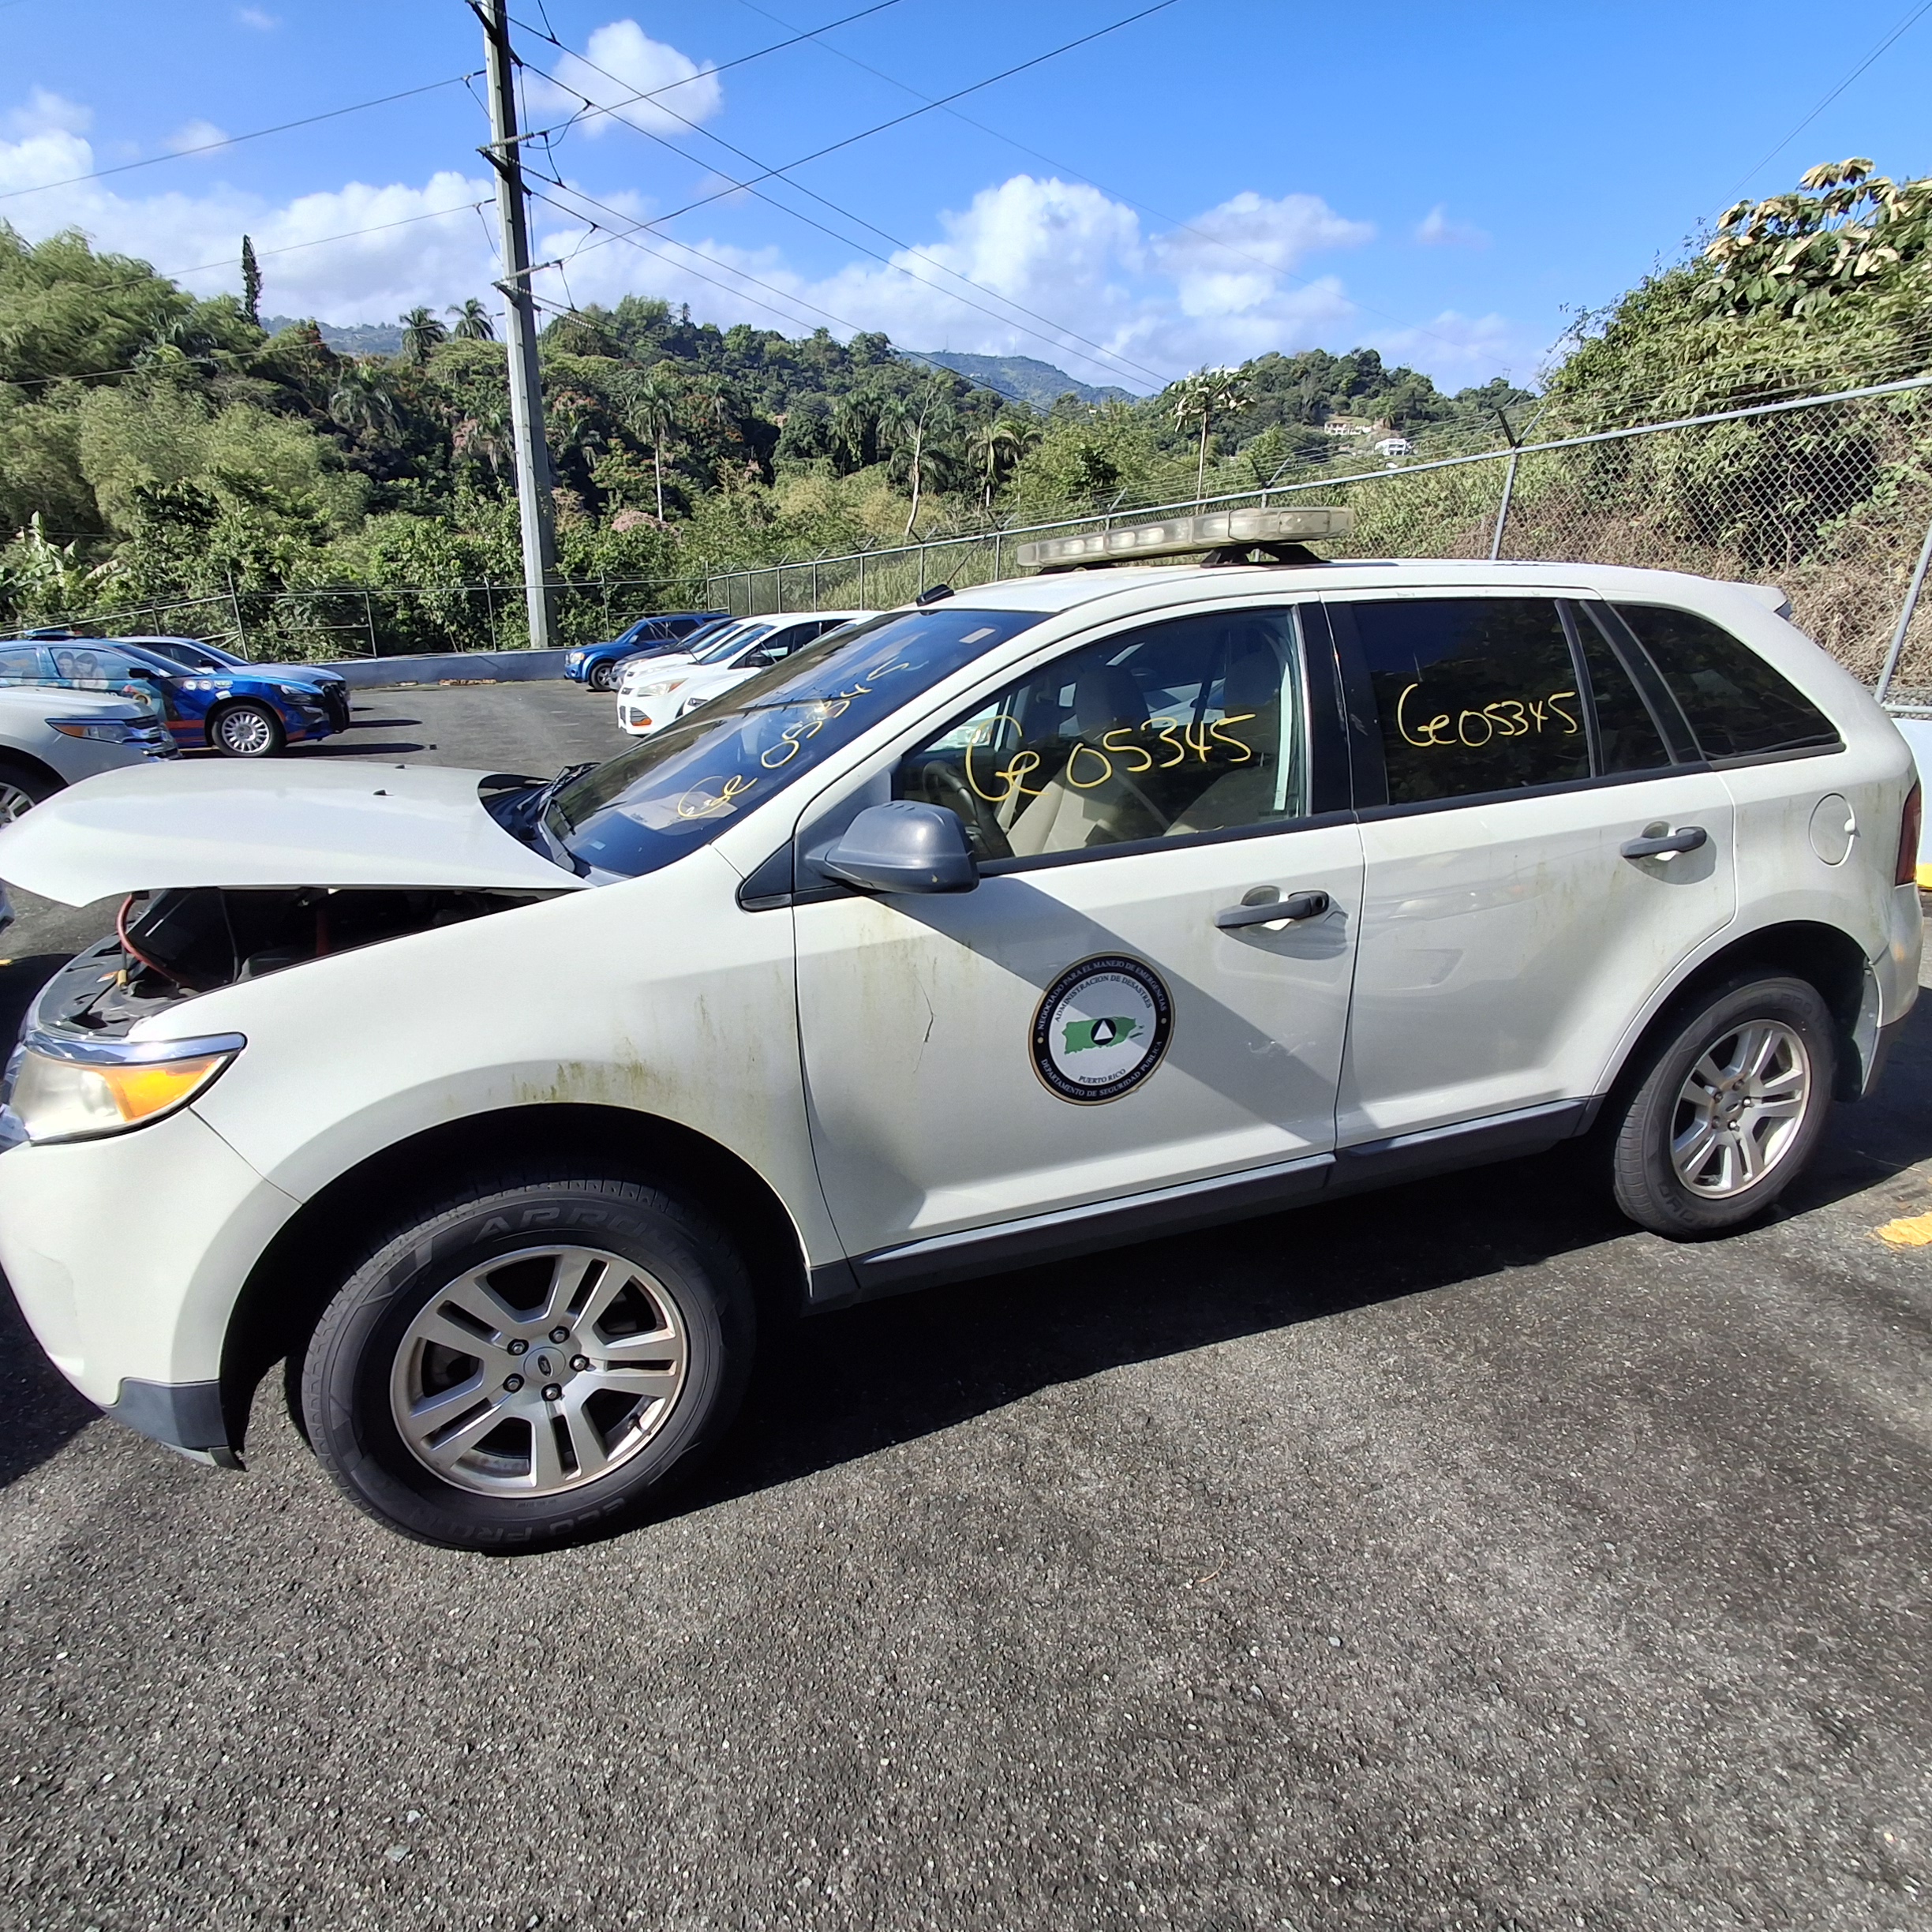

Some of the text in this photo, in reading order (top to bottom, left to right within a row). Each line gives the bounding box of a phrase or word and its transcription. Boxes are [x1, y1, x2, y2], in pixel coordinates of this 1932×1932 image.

[1066, 713, 1256, 788] 05345
[1038, 983, 1065, 1030] NEGOCIADO
[1064, 970, 1083, 987] PARA
[1093, 960, 1125, 968] MANEJO
[1135, 966, 1168, 1012] EMERGENCIAS
[1121, 977, 1153, 1009] DESASTRES
[1040, 1058, 1085, 1096] DEPARTAMENTO
[1099, 1072, 1141, 1095] SEGURIDAD
[1078, 1069, 1126, 1084] PUERTO RICO
